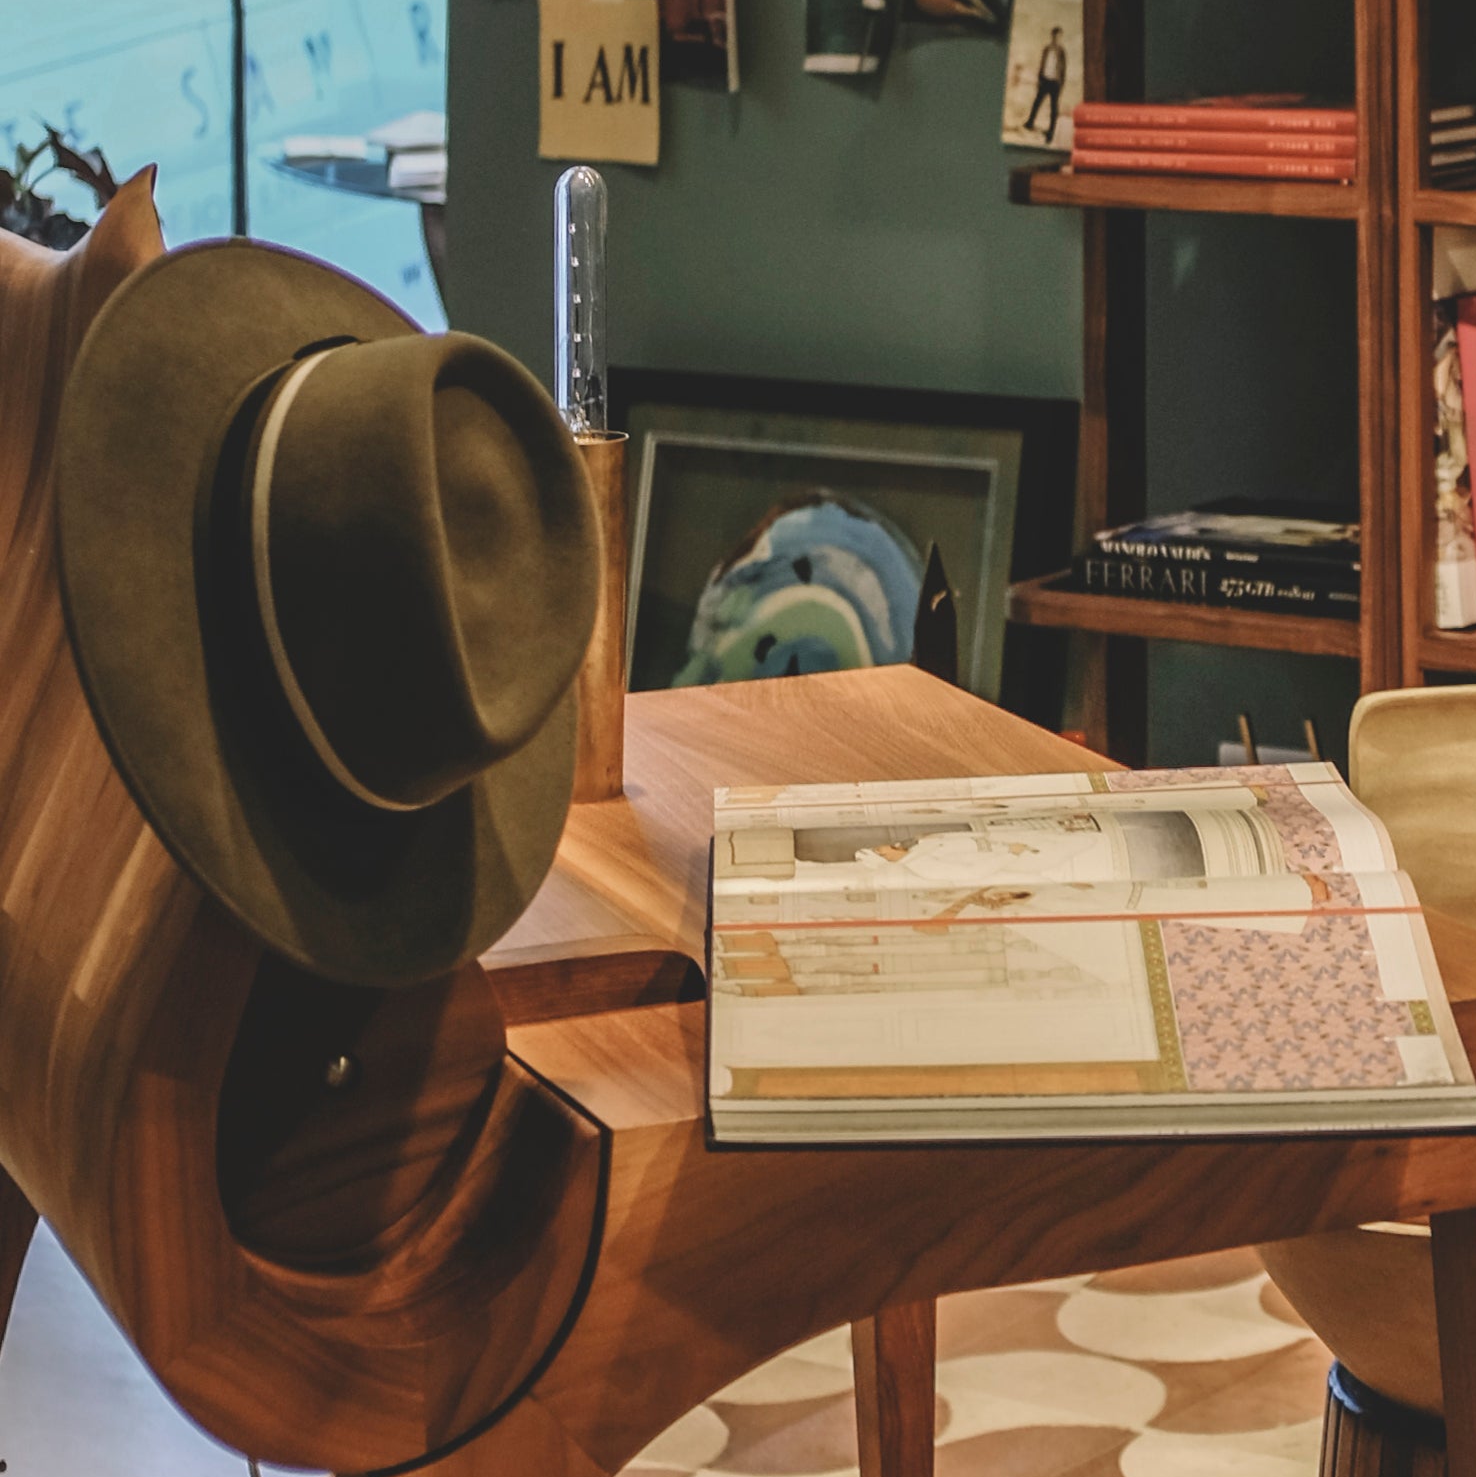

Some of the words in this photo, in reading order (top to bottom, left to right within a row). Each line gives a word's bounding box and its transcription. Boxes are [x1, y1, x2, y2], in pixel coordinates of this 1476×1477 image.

[552, 40, 565, 101] I
[583, 43, 653, 106] AM
[1086, 559, 1207, 595] FERRARI
